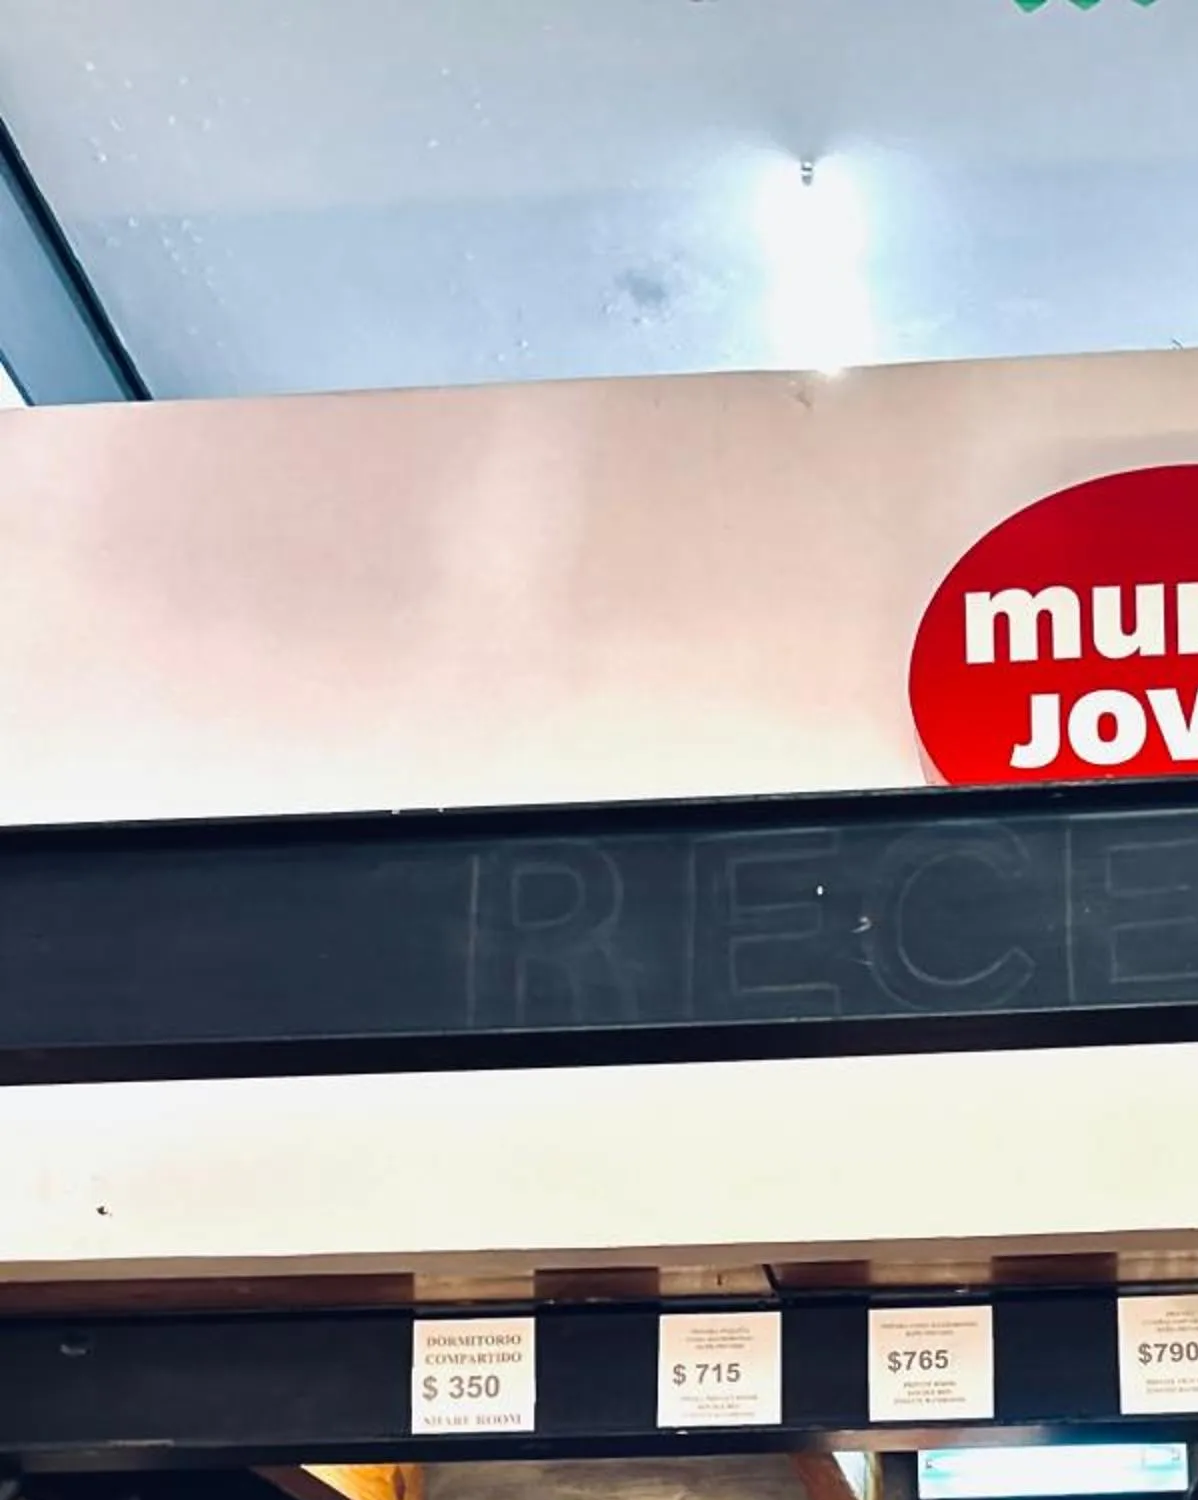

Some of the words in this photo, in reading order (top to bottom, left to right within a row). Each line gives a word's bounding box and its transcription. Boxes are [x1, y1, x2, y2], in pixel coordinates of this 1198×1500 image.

[426, 1335, 521, 1347] DORMITORIO
[425, 1352, 522, 1365] COMPARTIDO
[887, 1349, 949, 1374] $765
